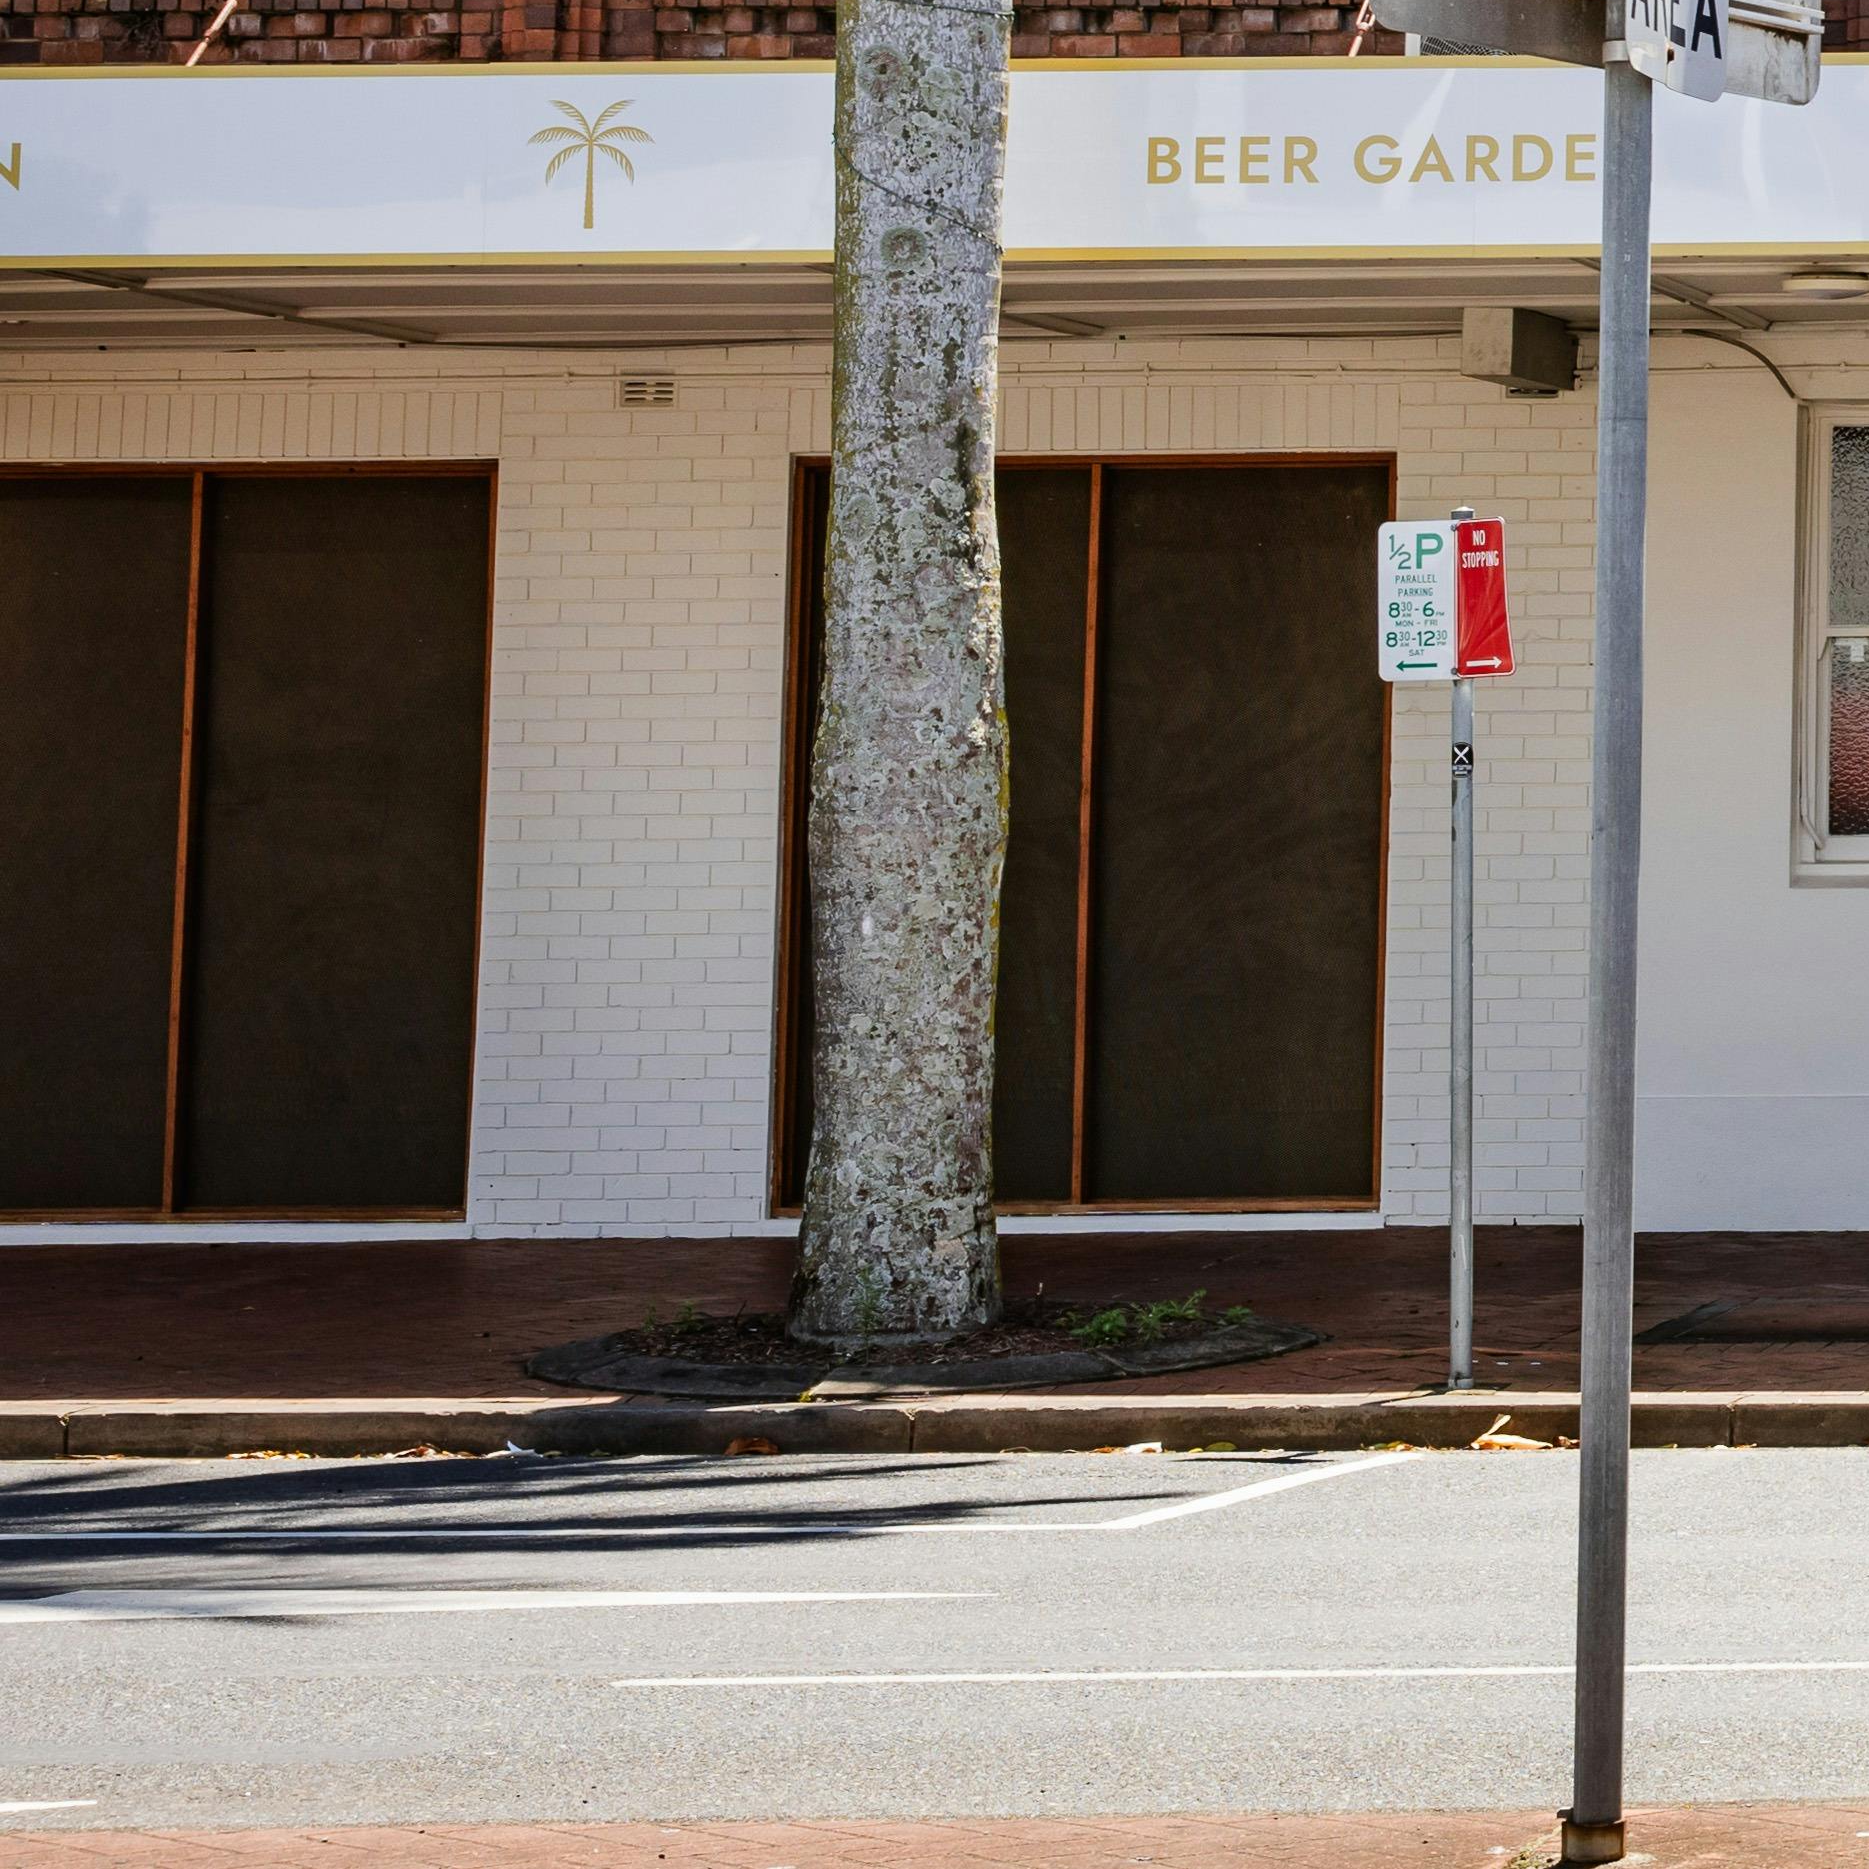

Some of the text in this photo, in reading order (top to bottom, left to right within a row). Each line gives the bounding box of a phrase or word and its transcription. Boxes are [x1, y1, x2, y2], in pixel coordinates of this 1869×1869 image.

[1147, 132, 1599, 185] BEER GARDE
[1472, 529, 1485, 546] NO
[1462, 550, 1499, 569] STOPPING
[1395, 574, 1437, 584] PARALLEL
[1398, 587, 1433, 597] PARKING
[1424, 619, 1438, 627] FRI
[1408, 649, 1425, 657] SAT
